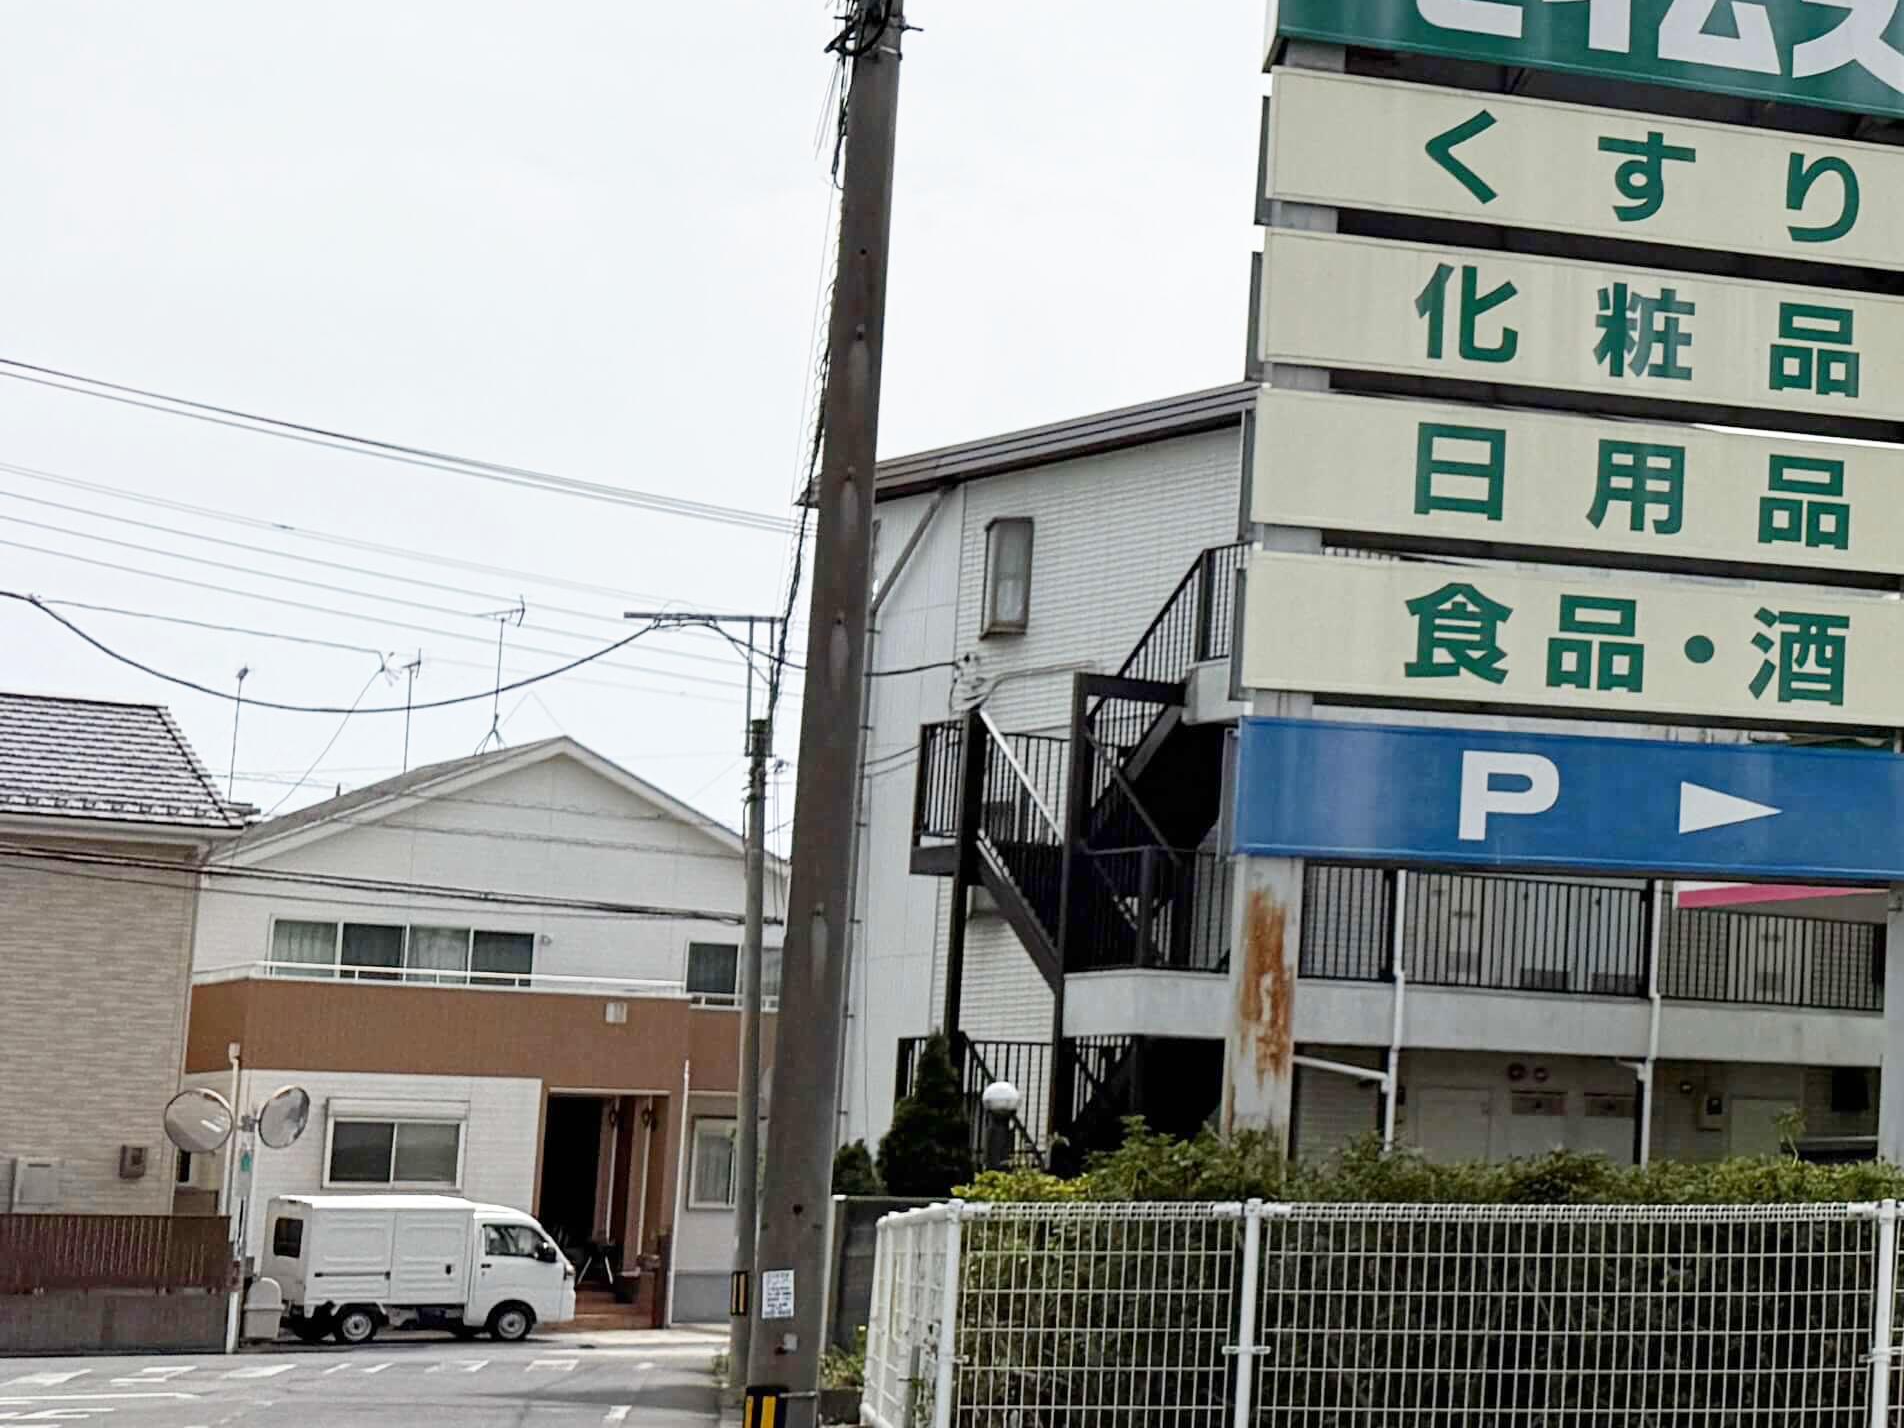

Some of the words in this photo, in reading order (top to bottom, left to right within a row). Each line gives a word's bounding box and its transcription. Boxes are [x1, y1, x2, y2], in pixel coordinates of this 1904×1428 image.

[1424, 108, 1861, 243] くすり
[1415, 263, 1861, 399] 化粧品
[1412, 421, 1852, 551] 日用品
[1404, 581, 1852, 707] 食品・酒
[1457, 749, 1561, 841] P
